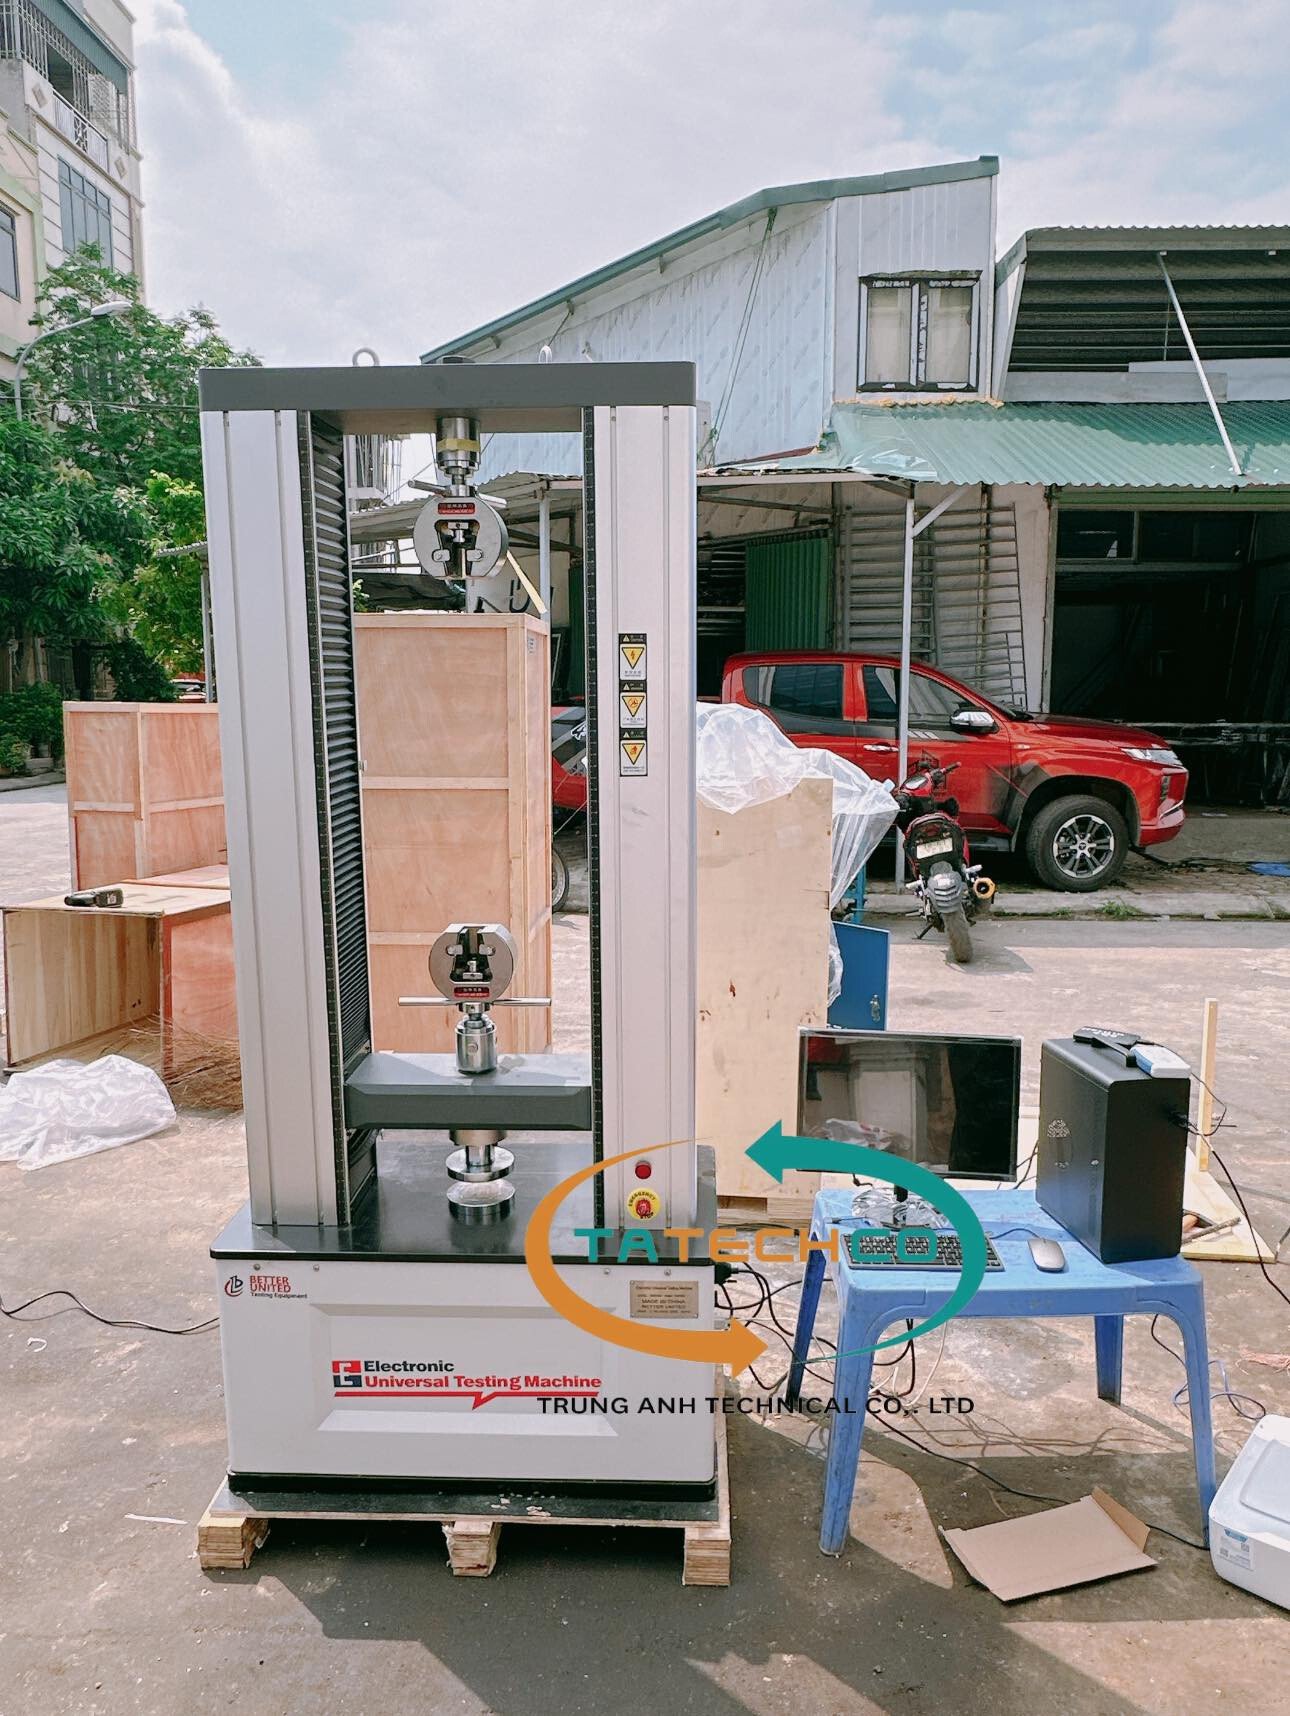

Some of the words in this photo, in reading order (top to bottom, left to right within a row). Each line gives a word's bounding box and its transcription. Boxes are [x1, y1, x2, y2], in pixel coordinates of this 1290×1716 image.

[249, 1275, 289, 1285] BETTER
[250, 1283, 292, 1293] UNITED
[364, 1360, 455, 1373] Electronic
[364, 1375, 449, 1388] Universal
[454, 1375, 522, 1391] Testing
[524, 1375, 602, 1388] Machine
